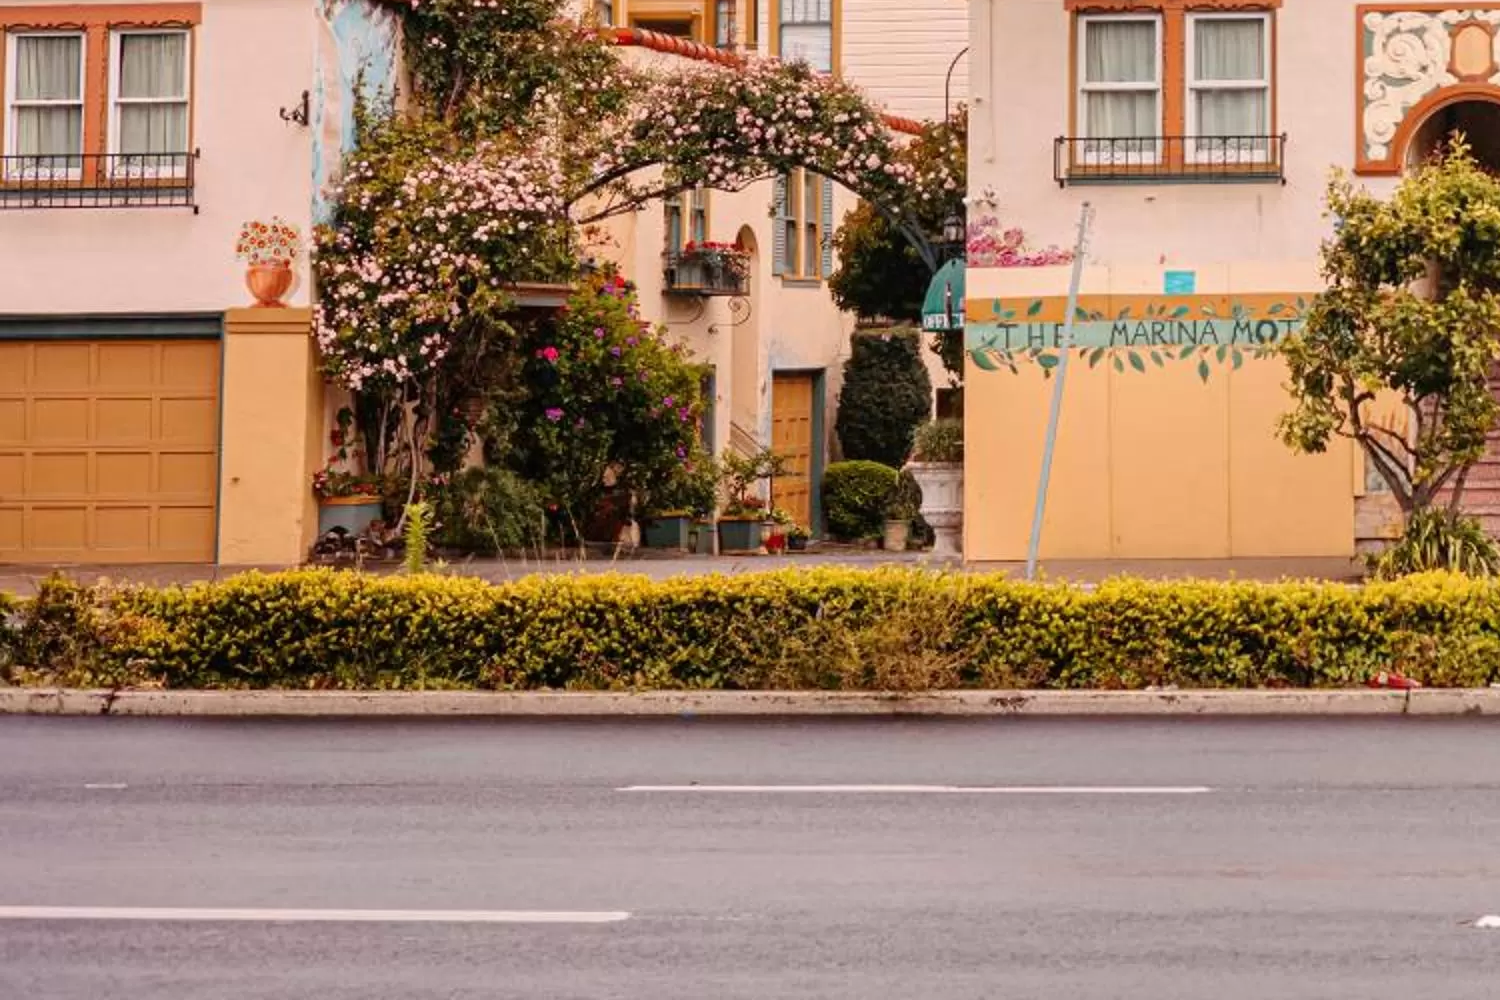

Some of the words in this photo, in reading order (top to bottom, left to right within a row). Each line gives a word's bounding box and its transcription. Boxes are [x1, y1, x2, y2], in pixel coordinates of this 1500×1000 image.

[996, 322, 1077, 349] THE
[1109, 319, 1219, 347] MARINA
[1231, 318, 1301, 345] MOT
